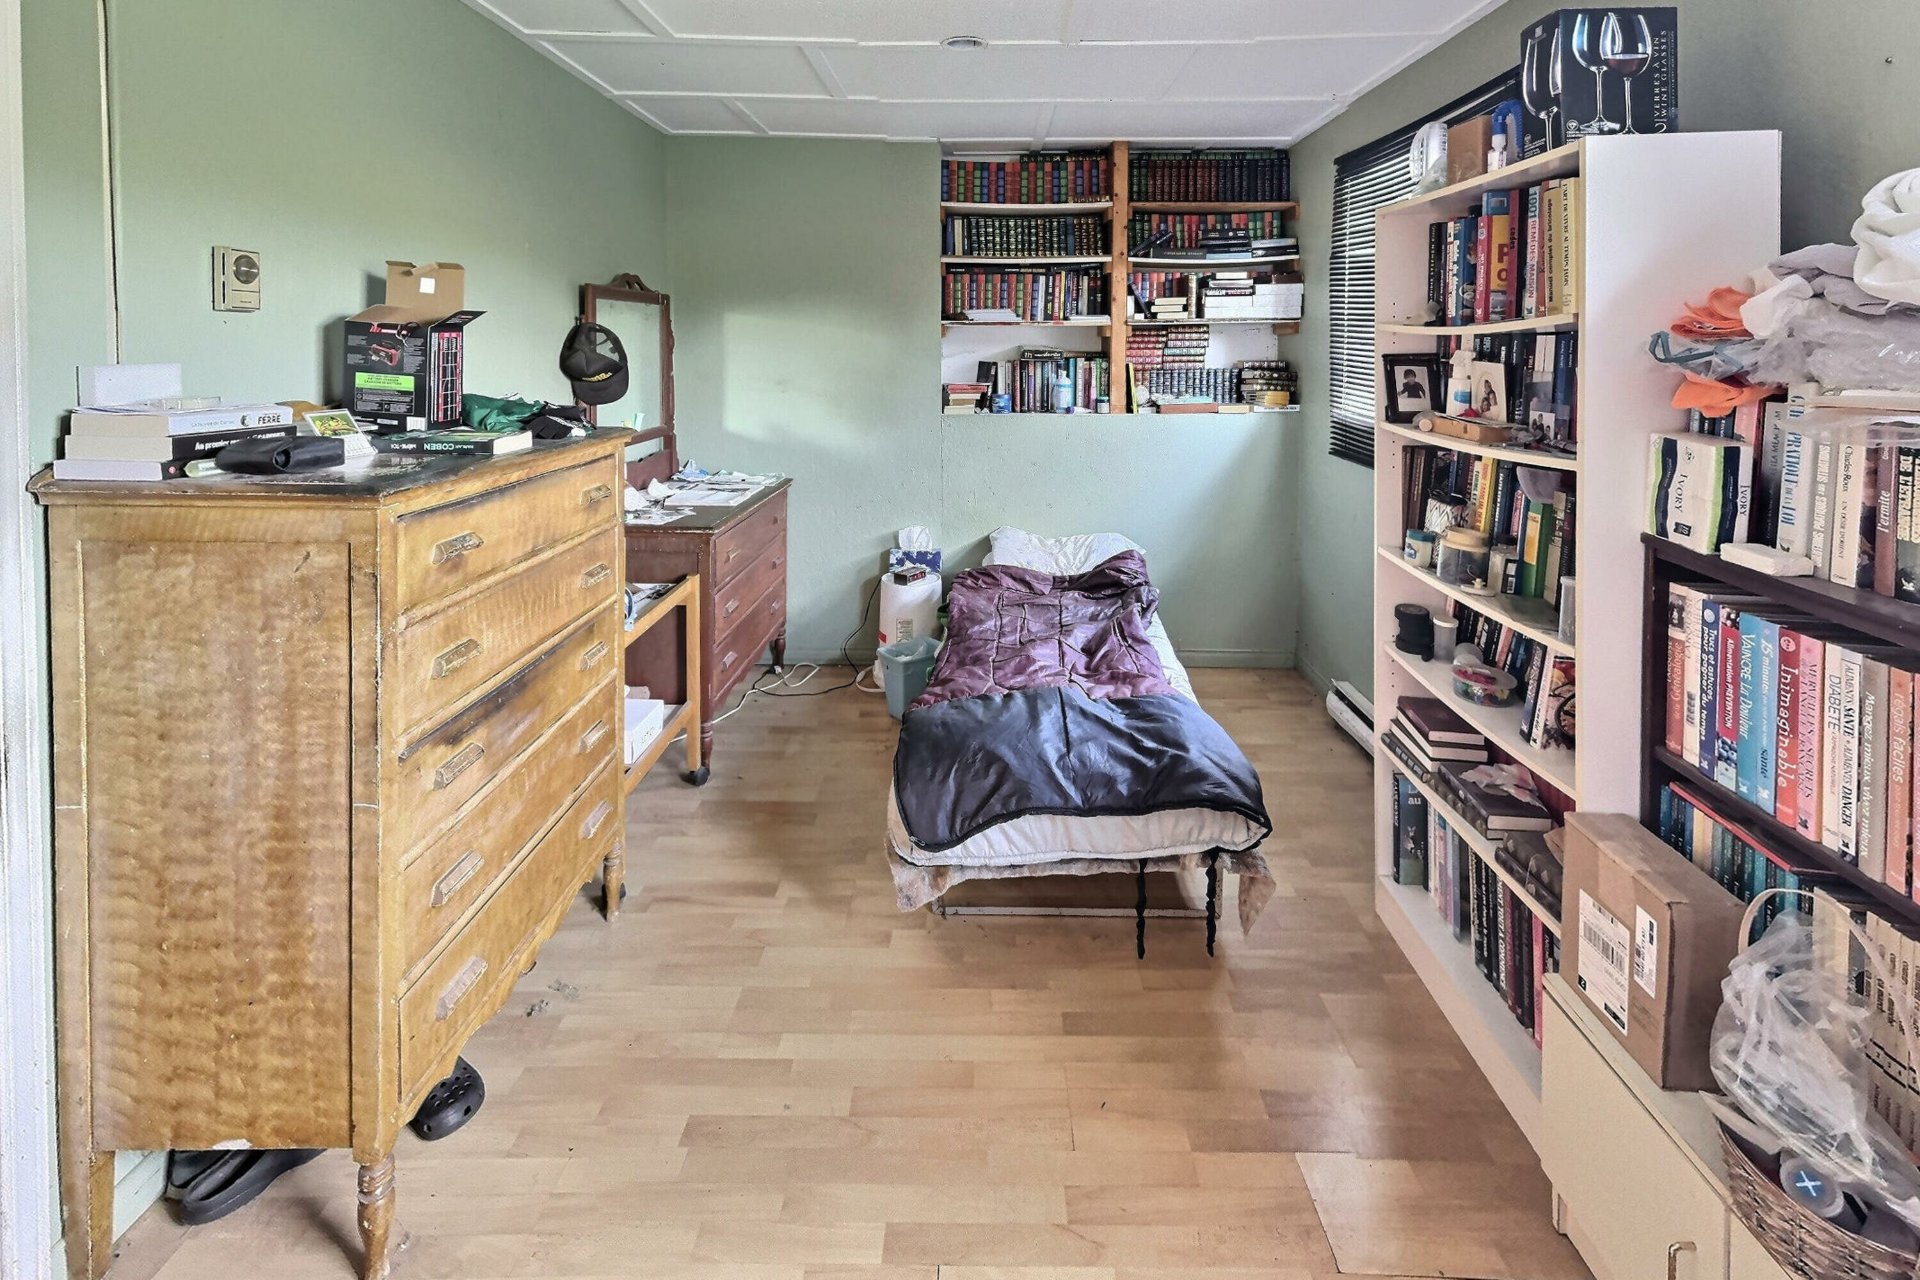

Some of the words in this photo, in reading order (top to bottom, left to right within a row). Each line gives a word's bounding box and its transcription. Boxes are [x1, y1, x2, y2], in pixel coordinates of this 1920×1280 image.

[1528, 190, 1538, 219] 1001
[1527, 263, 1536, 299] MAISON
[423, 443, 455, 451] COBEN
[1783, 431, 1802, 487] PRATIQUE
[1899, 455, 1913, 472] DE
[1674, 473, 1688, 514] IVORY
[1740, 485, 1751, 517] IVORY
[1876, 490, 1891, 533] l'ermite
[1780, 505, 1797, 527] LOI
[1708, 630, 1717, 652] Trucs
[1725, 637, 1735, 683] Alimentation
[1740, 633, 1756, 681] VAINCRE
[1761, 638, 1774, 654] 15
[1671, 642, 1683, 701] Généalogie
[1701, 653, 1709, 692] gagner
[1707, 663, 1715, 701] astuces
[1741, 682, 1753, 695] La
[1761, 656, 1771, 695] minutes
[1843, 664, 1855, 705] ALIMENTS
[1724, 684, 1734, 729] PRÉVENTION
[1738, 698, 1753, 740] Douleur
[1806, 663, 1818, 735] MERVEILLES
[1863, 691, 1876, 740] Mangez
[1892, 692, 1906, 734] régals
[1777, 663, 1799, 788] Inimaginable
[1804, 745, 1815, 799] SECRETS
[1842, 744, 1854, 785] ALIMENTS
[1862, 742, 1874, 782] mieux
[1891, 735, 1906, 783] faciles
[1407, 796, 1421, 805] au
[1841, 785, 1853, 827] DANGER
[1861, 785, 1873, 816] vivez
[1859, 817, 1870, 858] mieux
